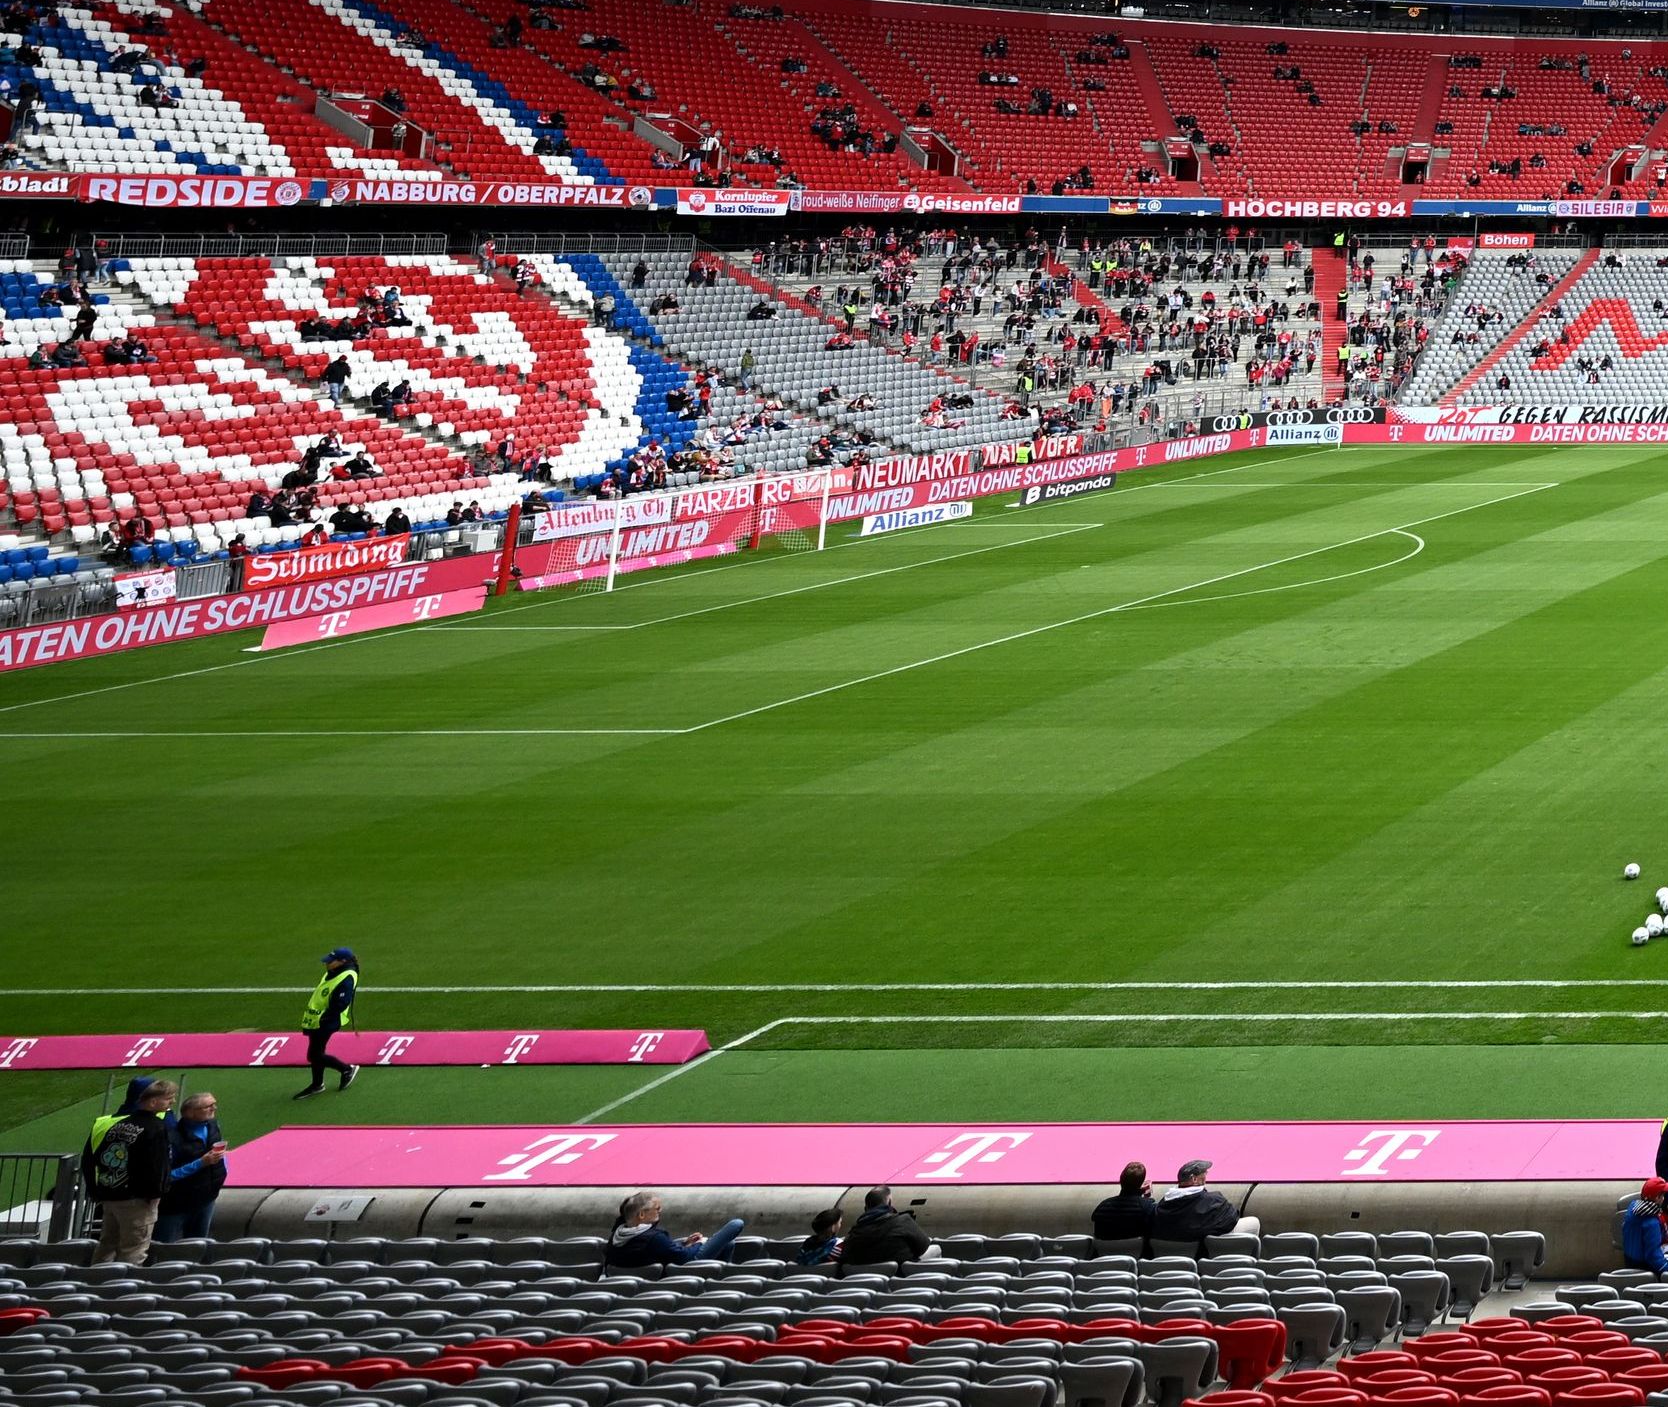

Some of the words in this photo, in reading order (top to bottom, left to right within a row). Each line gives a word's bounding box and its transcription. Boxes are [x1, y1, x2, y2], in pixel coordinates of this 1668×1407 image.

[89, 178, 272, 207] REDSIDE
[356, 182, 477, 203] NABBURG
[497, 183, 624, 206] OBERPFALZ
[714, 189, 778, 203] Kornlupfer
[921, 195, 1020, 212] Geisenfeld
[714, 203, 737, 215] Bazi
[738, 203, 777, 215] Offenau
[1570, 203, 1625, 215] SILESIA
[1484, 233, 1528, 246] Böhen
[1498, 405, 1568, 424] GEGEN
[1268, 428, 1321, 441] Allianz
[1424, 425, 1515, 442] UNLIMITED
[1530, 424, 1587, 442] DATEN
[1587, 424, 1636, 441] OHNE
[1164, 434, 1232, 460] UNLIMITED
[857, 452, 969, 491] NEUMARKT
[928, 473, 981, 503] DATEN
[980, 469, 1022, 492] OHNE
[1022, 452, 1118, 485] SCHLUSSPFIFF
[1045, 473, 1112, 498] bitpanda
[870, 503, 944, 532] Allianz
[248, 536, 408, 585] Schmiding
[95, 603, 200, 650] OHNE
[204, 566, 428, 632] SCHLUSSPFIFF
